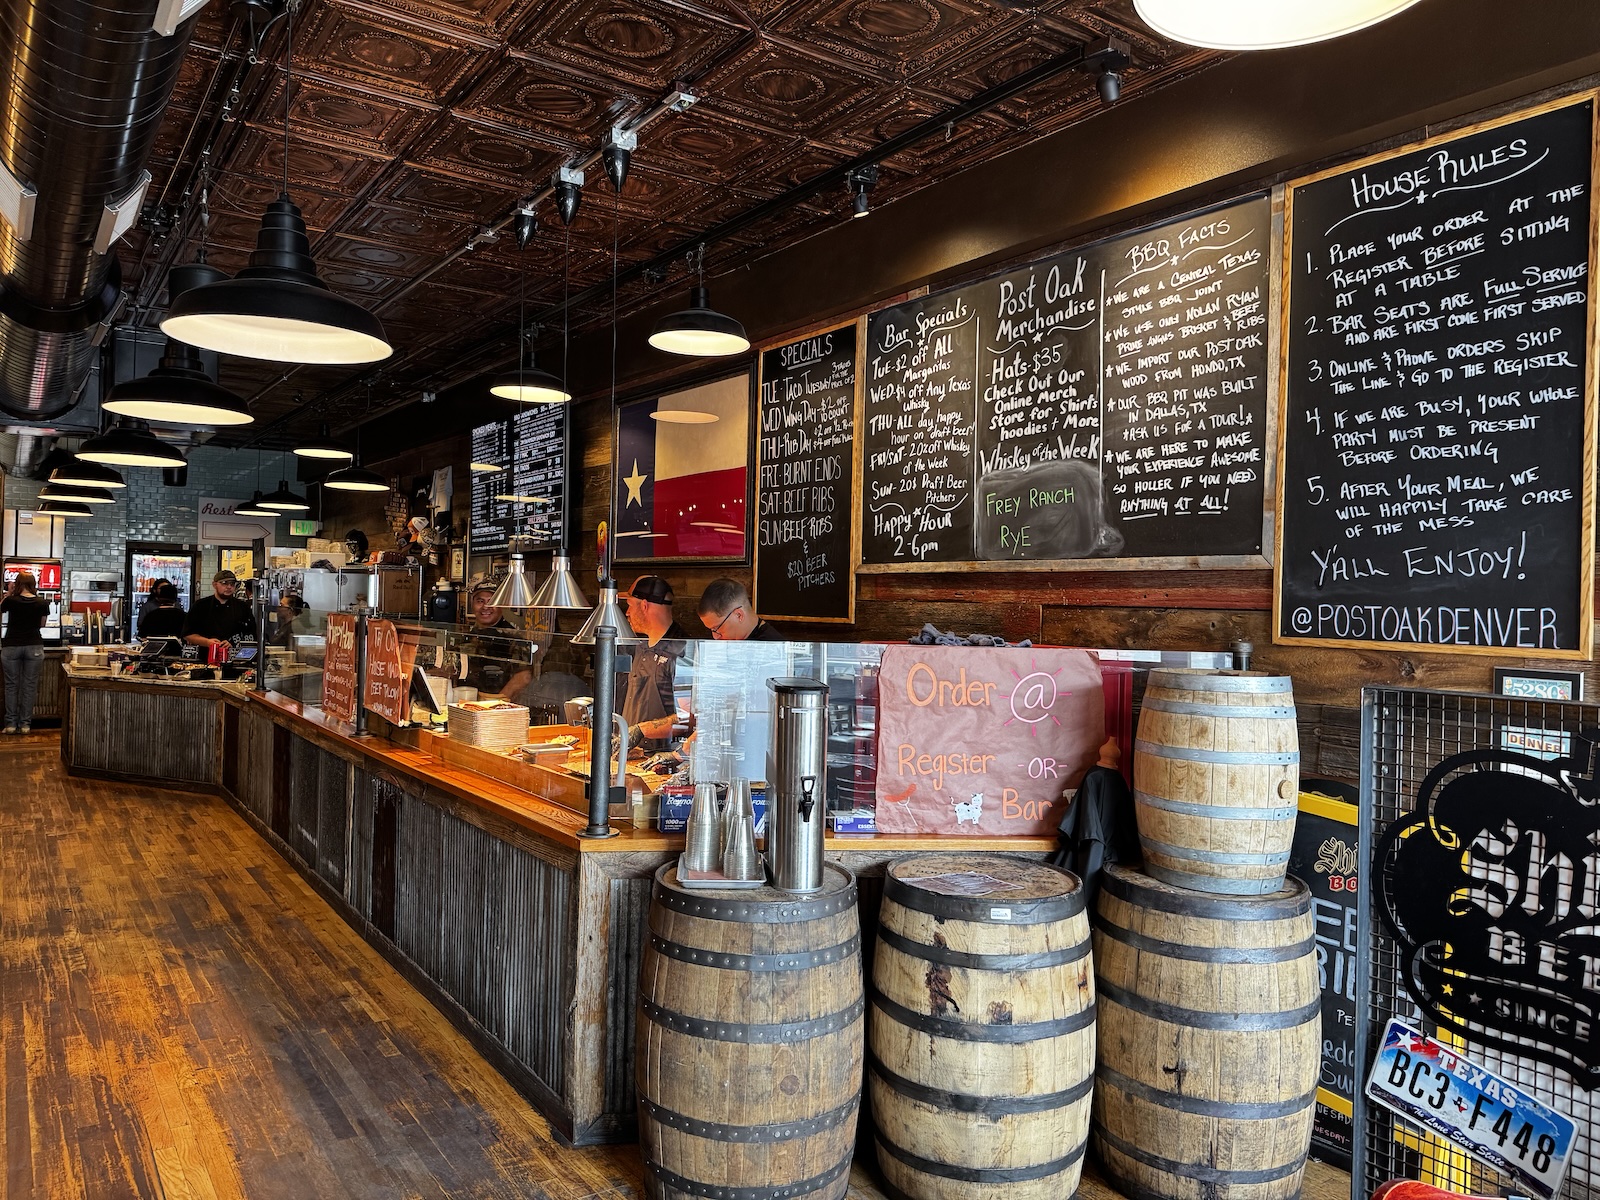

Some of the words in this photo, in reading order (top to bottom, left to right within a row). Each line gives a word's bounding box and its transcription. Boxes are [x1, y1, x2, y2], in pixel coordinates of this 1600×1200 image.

[1350, 166, 1430, 208] HOUSE
[1427, 138, 1528, 183] RULES
[1125, 239, 1170, 272] BBQ
[1178, 219, 1230, 249] FACTS
[1326, 256, 1413, 289] REGISTER
[1420, 233, 1485, 267] BEFORE
[1499, 215, 1570, 245] SITTING
[998, 274, 1036, 319] Post
[1121, 301, 1153, 319] STYLE
[1159, 294, 1182, 308] BBQ
[1186, 280, 1223, 301] JOINT
[1335, 290, 1358, 308] AT
[1375, 283, 1388, 297] A
[1396, 264, 1461, 293] TABLE
[885, 324, 909, 347] Bar
[916, 297, 968, 338] Specials
[996, 298, 1096, 342] Merchandise
[1135, 321, 1154, 334] USE
[1159, 314, 1179, 328] ONLY
[1186, 297, 1221, 322] NOLAN
[1226, 286, 1260, 309] RYAN
[1116, 340, 1143, 355] PRIME
[1147, 332, 1174, 347] ANGUS
[1178, 319, 1219, 338] BRISKET
[1230, 302, 1261, 322] BEEF
[781, 334, 832, 366] SPECIALS
[1033, 343, 1064, 374] $35
[1329, 357, 1378, 378] ONLINE
[1394, 349, 1438, 367] PHONE
[1447, 339, 1506, 359] ORDERS
[1515, 327, 1562, 350] SKIP
[783, 377, 802, 401] TACO
[909, 384, 923, 398] off
[926, 381, 946, 402] Any
[948, 376, 971, 392] Texas
[984, 378, 1024, 401] Check
[1028, 373, 1053, 392] Out
[1058, 369, 1085, 384] Our
[994, 397, 1032, 415] Online
[1037, 385, 1077, 404] Merch
[1118, 395, 1141, 411] OUR
[1146, 390, 1168, 405] BBQ
[1173, 389, 1189, 401] PIT
[1194, 386, 1217, 399] WAS
[1222, 376, 1257, 395] BUILT
[1030, 407, 1052, 421] for
[1060, 394, 1098, 415] Shirts
[1000, 421, 1048, 441] hoodies
[1063, 414, 1099, 429] More
[1153, 424, 1168, 437] US
[1175, 420, 1192, 435] FOR
[1198, 419, 1206, 430] A
[1332, 428, 1377, 450] PARTY
[1389, 426, 1425, 443] MUST
[1437, 424, 1457, 438] BE
[1469, 414, 1541, 435] PRESENT
[979, 443, 1031, 475] Whiskey
[1033, 443, 1043, 456] of
[1040, 444, 1057, 461] the
[1117, 463, 1141, 479] YOUR
[1145, 455, 1206, 474] EXPERIENCE
[1211, 448, 1262, 468] AWESOME
[1337, 450, 1397, 468] BEFORE
[1410, 439, 1499, 464] ORDERING
[784, 460, 812, 485] BURNT
[815, 455, 841, 481] ENDS
[900, 477, 917, 492] 20$
[922, 473, 944, 489] Draft
[947, 474, 967, 489] Beer
[1307, 475, 1330, 506] 5.
[1340, 481, 1391, 501] AFTER
[1398, 473, 1442, 499] YOUR
[1447, 474, 1504, 493] MEAL,
[1510, 466, 1540, 487] WE
[784, 487, 809, 513] BEEF
[812, 486, 835, 512] RIBS
[926, 490, 956, 503] Pitchers
[986, 493, 1021, 517] FREY
[1030, 487, 1075, 508] RANCH
[1120, 498, 1168, 516] ANYTHING
[1174, 497, 1193, 510] AT
[1200, 488, 1230, 511] ALL!
[1335, 504, 1371, 521] WILL
[1379, 498, 1448, 518] HAPPILY
[1461, 497, 1508, 514] TAKE
[1521, 488, 1574, 505] CARE
[1345, 525, 1363, 539] OF
[1372, 522, 1403, 536] THE
[1419, 516, 1475, 532] MESS
[787, 560, 803, 578] $20
[806, 553, 828, 573] BEER
[1311, 543, 1390, 586] Y'ALL
[1403, 531, 1527, 581] ENJOY!
[798, 571, 835, 591] PITCHERS
[1291, 603, 1560, 649] @POSTOAKDENVER
[906, 662, 997, 707] Order
[1010, 672, 1056, 723] @
[1512, 683, 1559, 699] 5280
[898, 743, 996, 791] Register
[666, 796, 693, 806] Reynol
[1002, 787, 1053, 821] Bar
[1328, 875, 1358, 892] BO
[1495, 998, 1591, 1043] SINCE
[1438, 1050, 1519, 1109] TEXAS
[1388, 1048, 1450, 1111] BC3
[1469, 1093, 1556, 1174] F448
[1413, 1107, 1424, 1118] The
[1424, 1116, 1449, 1135] Lone
[1450, 1127, 1474, 1150] Star
[1476, 1144, 1505, 1167] State
